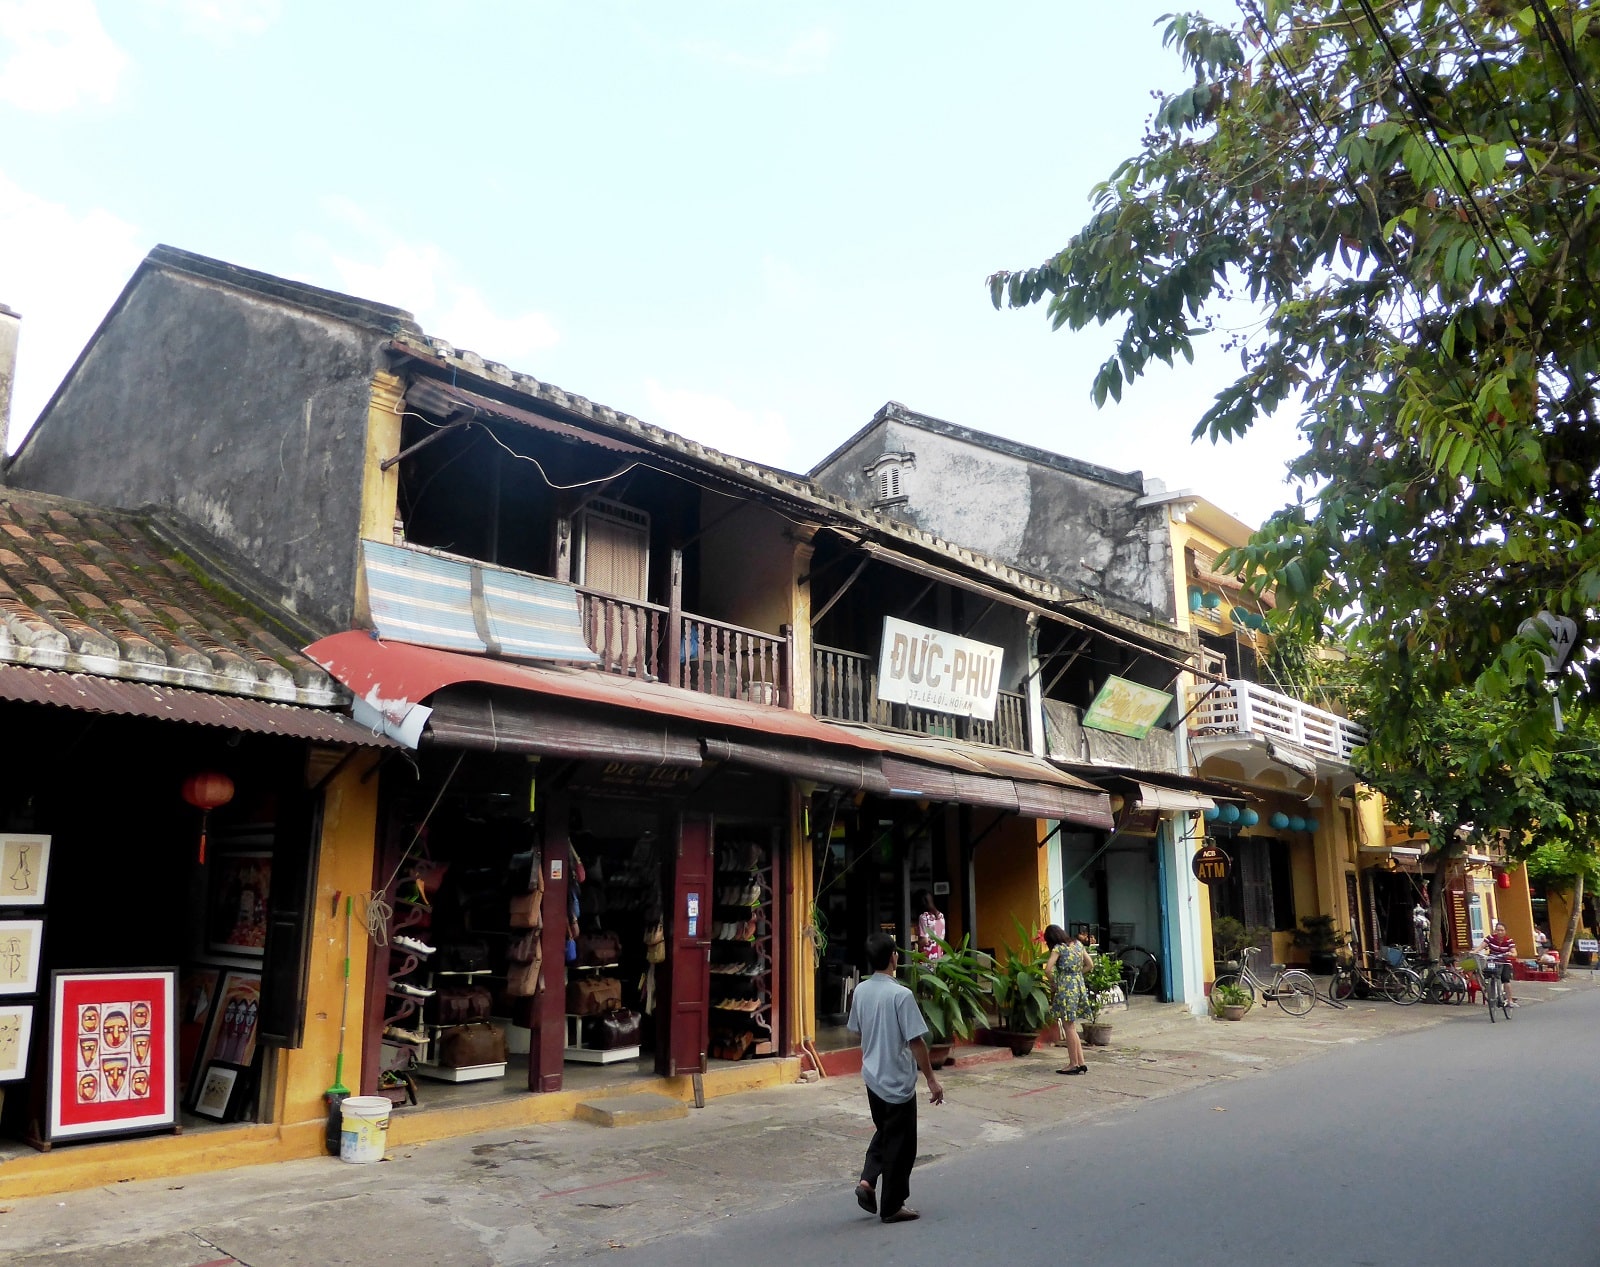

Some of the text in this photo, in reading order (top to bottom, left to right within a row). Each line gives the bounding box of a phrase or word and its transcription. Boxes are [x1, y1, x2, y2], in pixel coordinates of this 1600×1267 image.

[890, 631, 995, 699] ĐỨC-PHÚ
[1202, 850, 1217, 858] ACB
[1197, 862, 1225, 879] ATM
